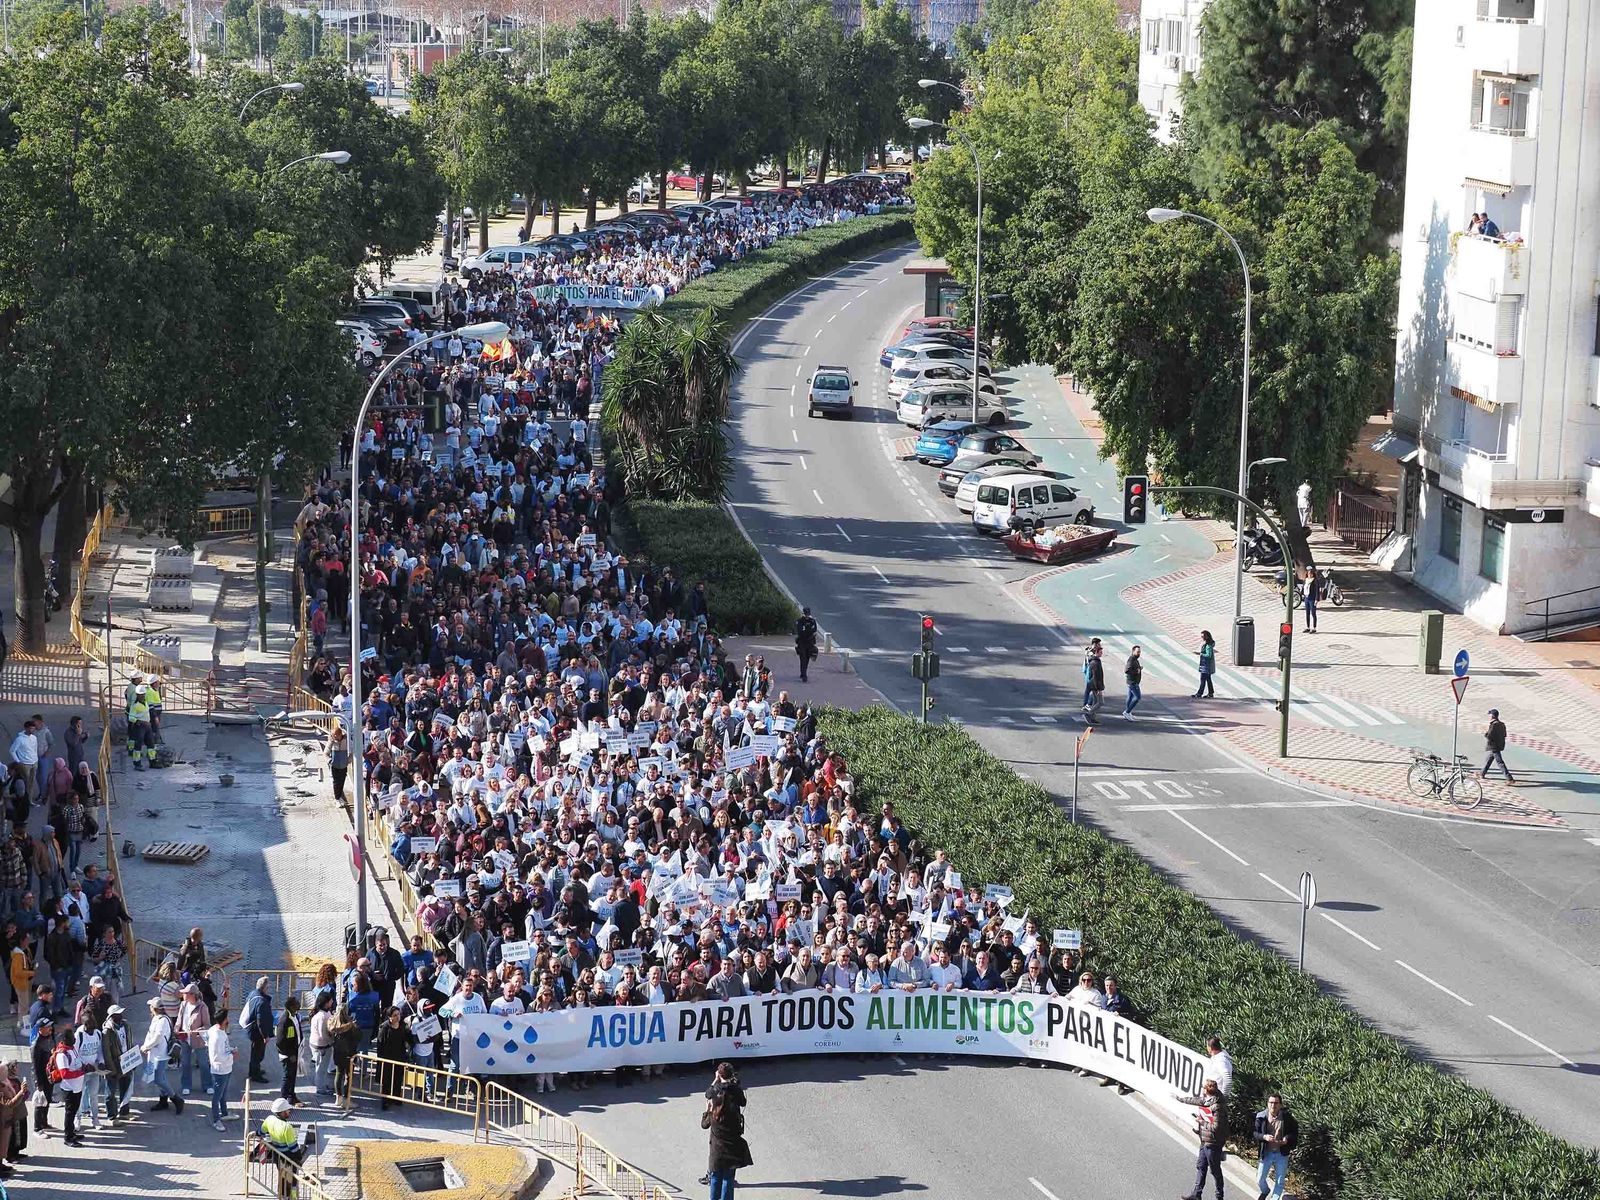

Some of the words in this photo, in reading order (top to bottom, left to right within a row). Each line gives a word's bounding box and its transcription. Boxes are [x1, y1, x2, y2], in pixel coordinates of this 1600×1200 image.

[587, 286, 610, 300] PARA
[611, 288, 621, 300] EL
[587, 1010, 666, 1048] AGUA
[678, 1004, 753, 1041] PARA
[761, 995, 855, 1034] TODOS
[866, 994, 1034, 1036] ALIMENTOS
[1047, 1002, 1107, 1053] PARA
[1113, 1021, 1136, 1065] EL
[1140, 1034, 1205, 1098] MUNDO
